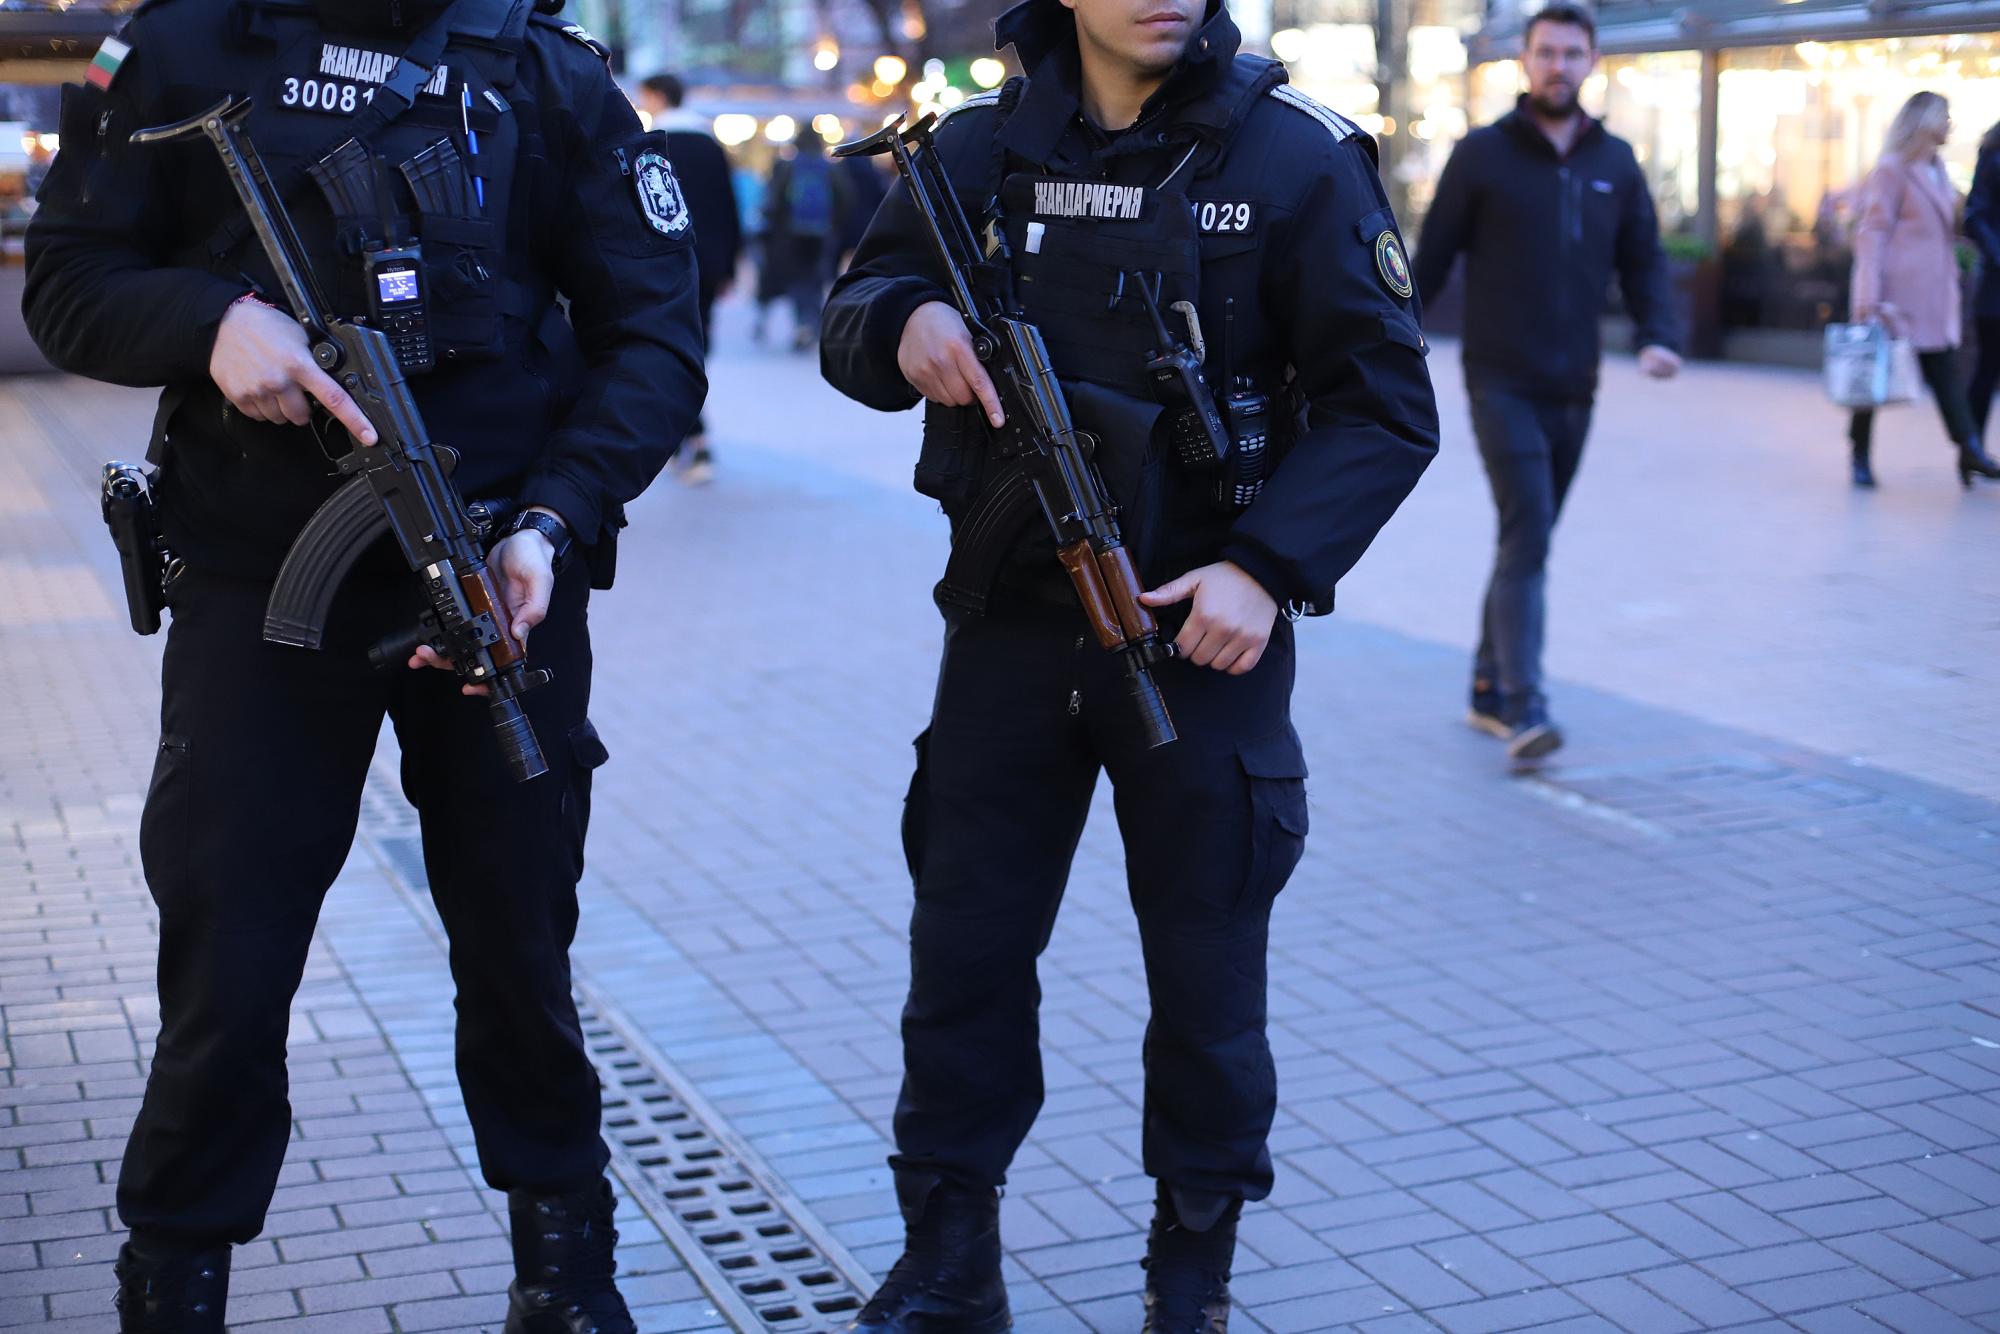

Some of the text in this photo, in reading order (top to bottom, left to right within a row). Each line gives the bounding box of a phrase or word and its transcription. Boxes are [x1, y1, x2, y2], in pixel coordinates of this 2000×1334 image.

[319, 43, 448, 96] ЖАНДАРЯ
[282, 77, 375, 112] 30081
[1034, 182, 1143, 218] ЖАНДАРМЕРИЯ
